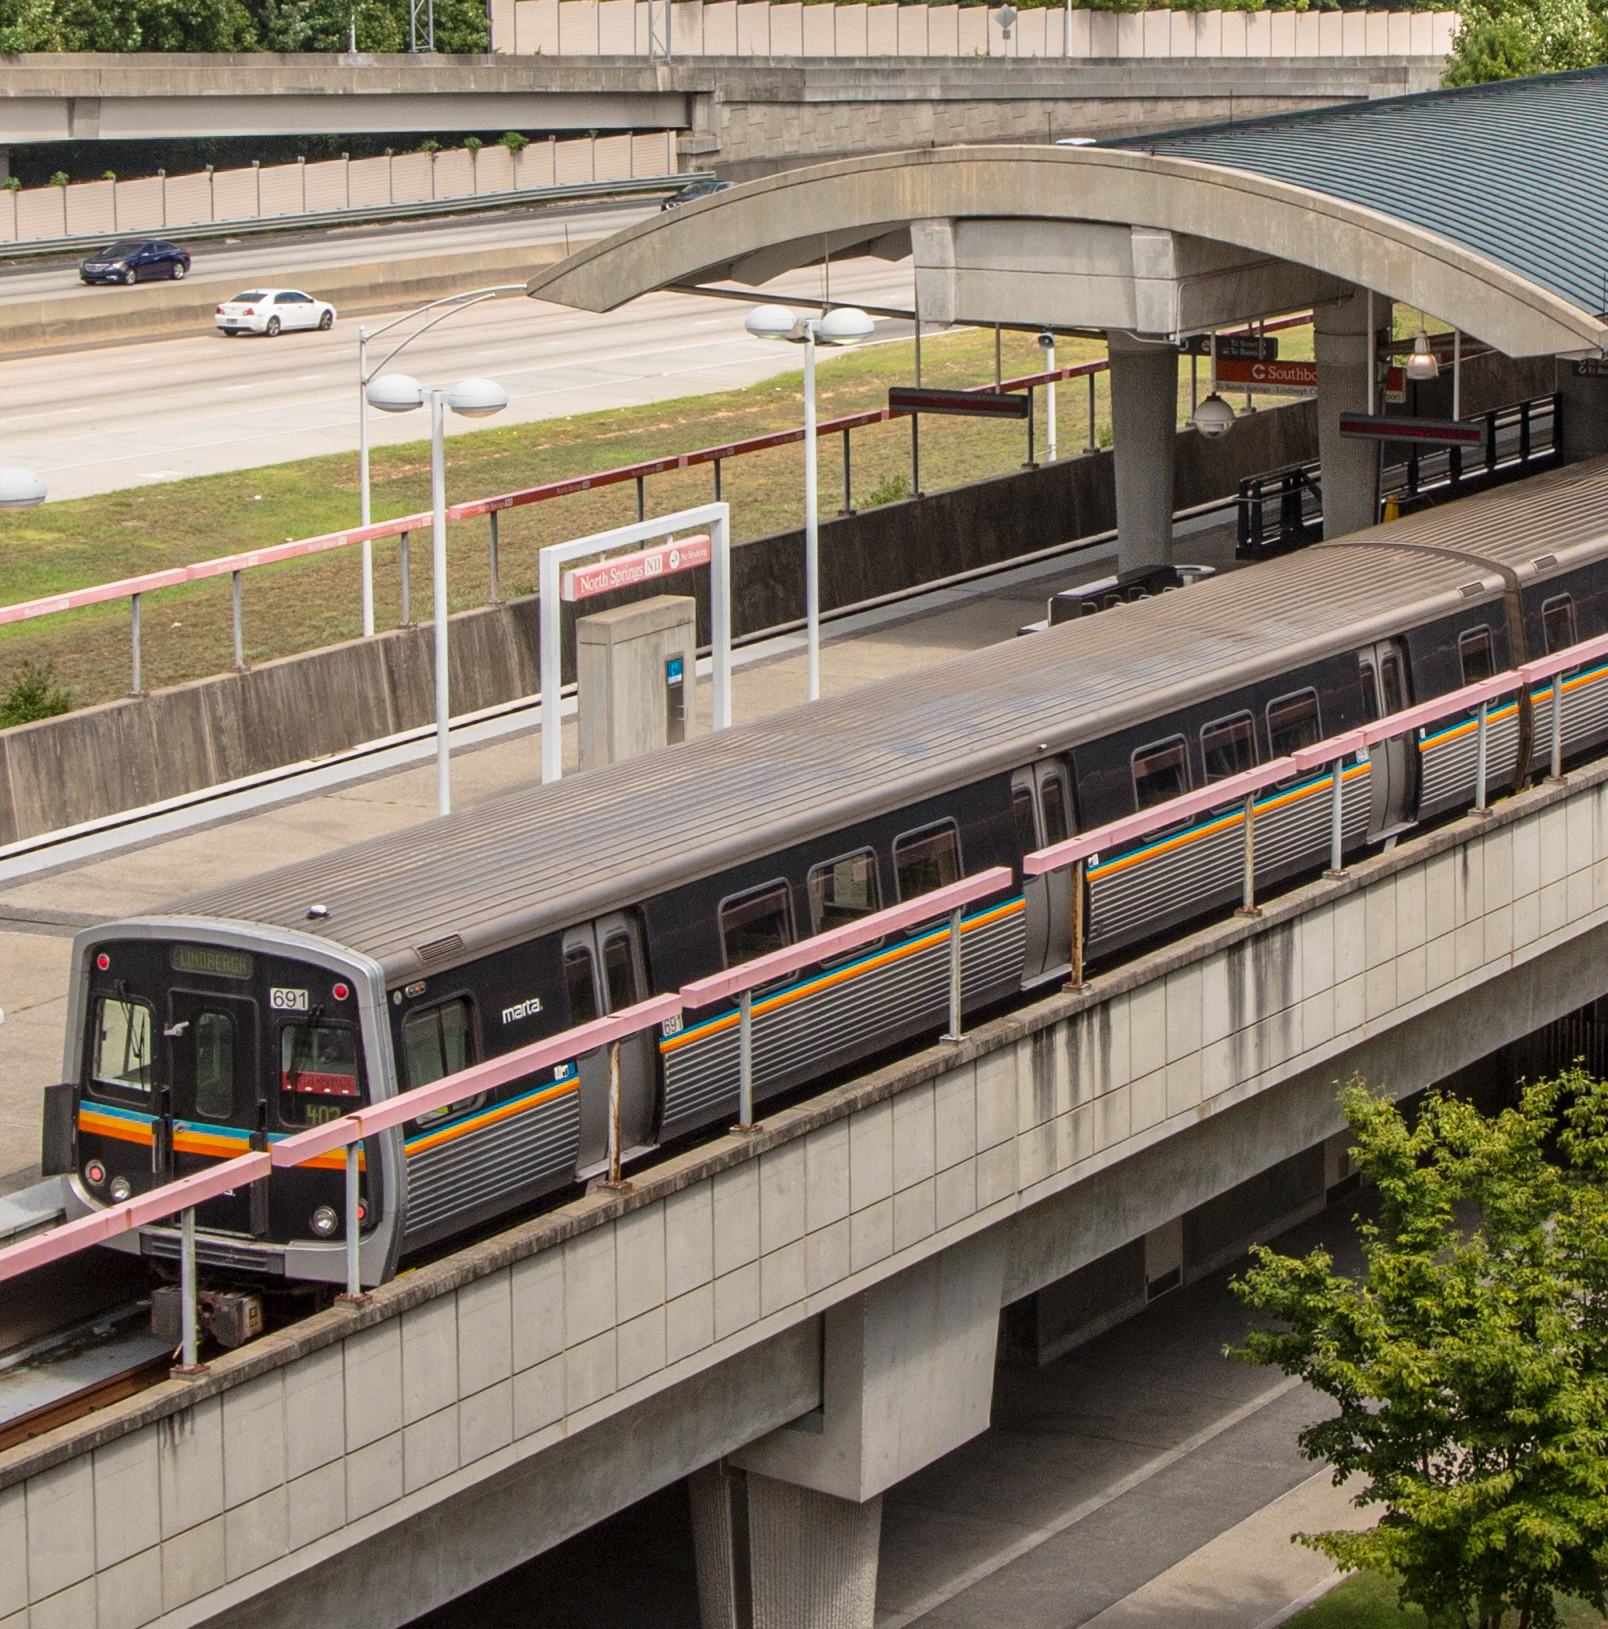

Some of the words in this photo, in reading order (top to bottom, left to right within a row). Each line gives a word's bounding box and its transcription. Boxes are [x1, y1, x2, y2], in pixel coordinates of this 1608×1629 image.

[581, 572, 608, 593] North
[611, 565, 643, 586] Springs
[646, 555, 662, 575] N11
[681, 552, 688, 561] No
[688, 548, 708, 561] Smoking
[179, 948, 247, 970] LINDBERGH
[273, 989, 308, 1009] 691
[502, 997, 541, 1024] marta
[663, 1015, 683, 1035] 691
